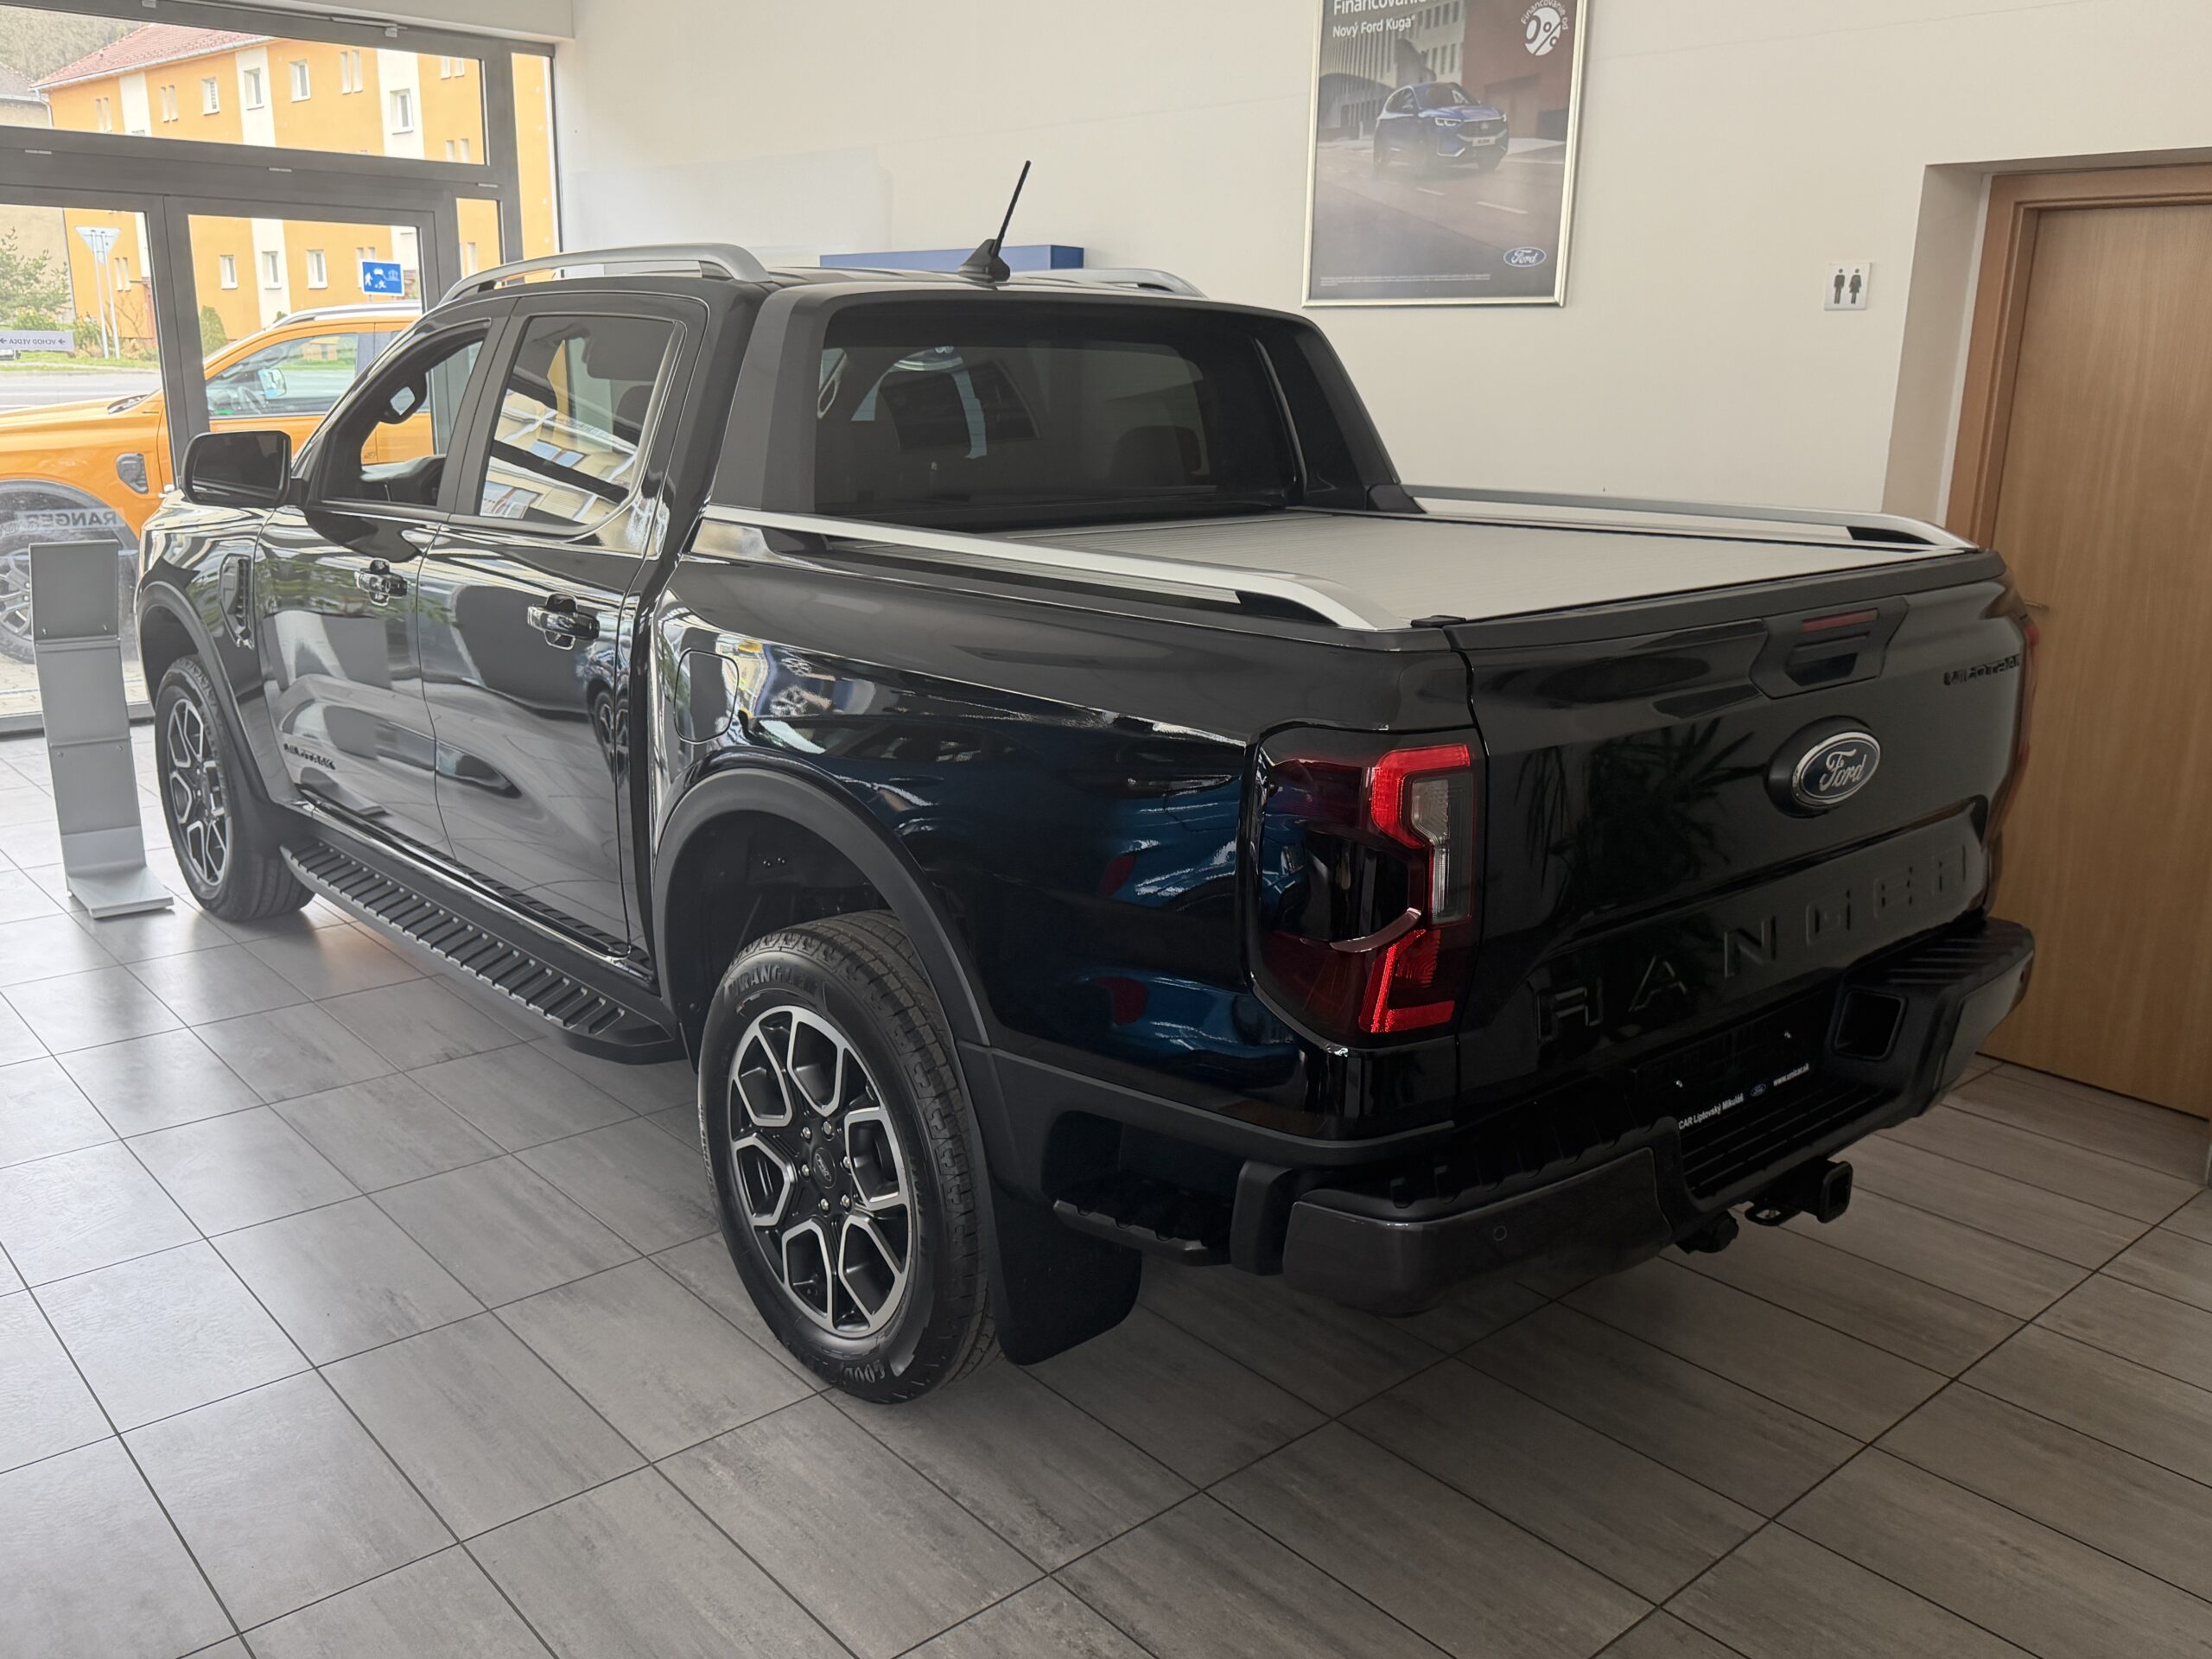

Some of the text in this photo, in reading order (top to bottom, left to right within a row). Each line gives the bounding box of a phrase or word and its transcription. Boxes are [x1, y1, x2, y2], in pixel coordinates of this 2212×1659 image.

[1333, 0, 1426, 16] Financovan
[1332, 22, 1359, 38] Nový
[1360, 19, 1383, 34] Ford
[1535, 843, 1967, 1045] RANGER
[1694, 1103, 1721, 1123] Liptovský
